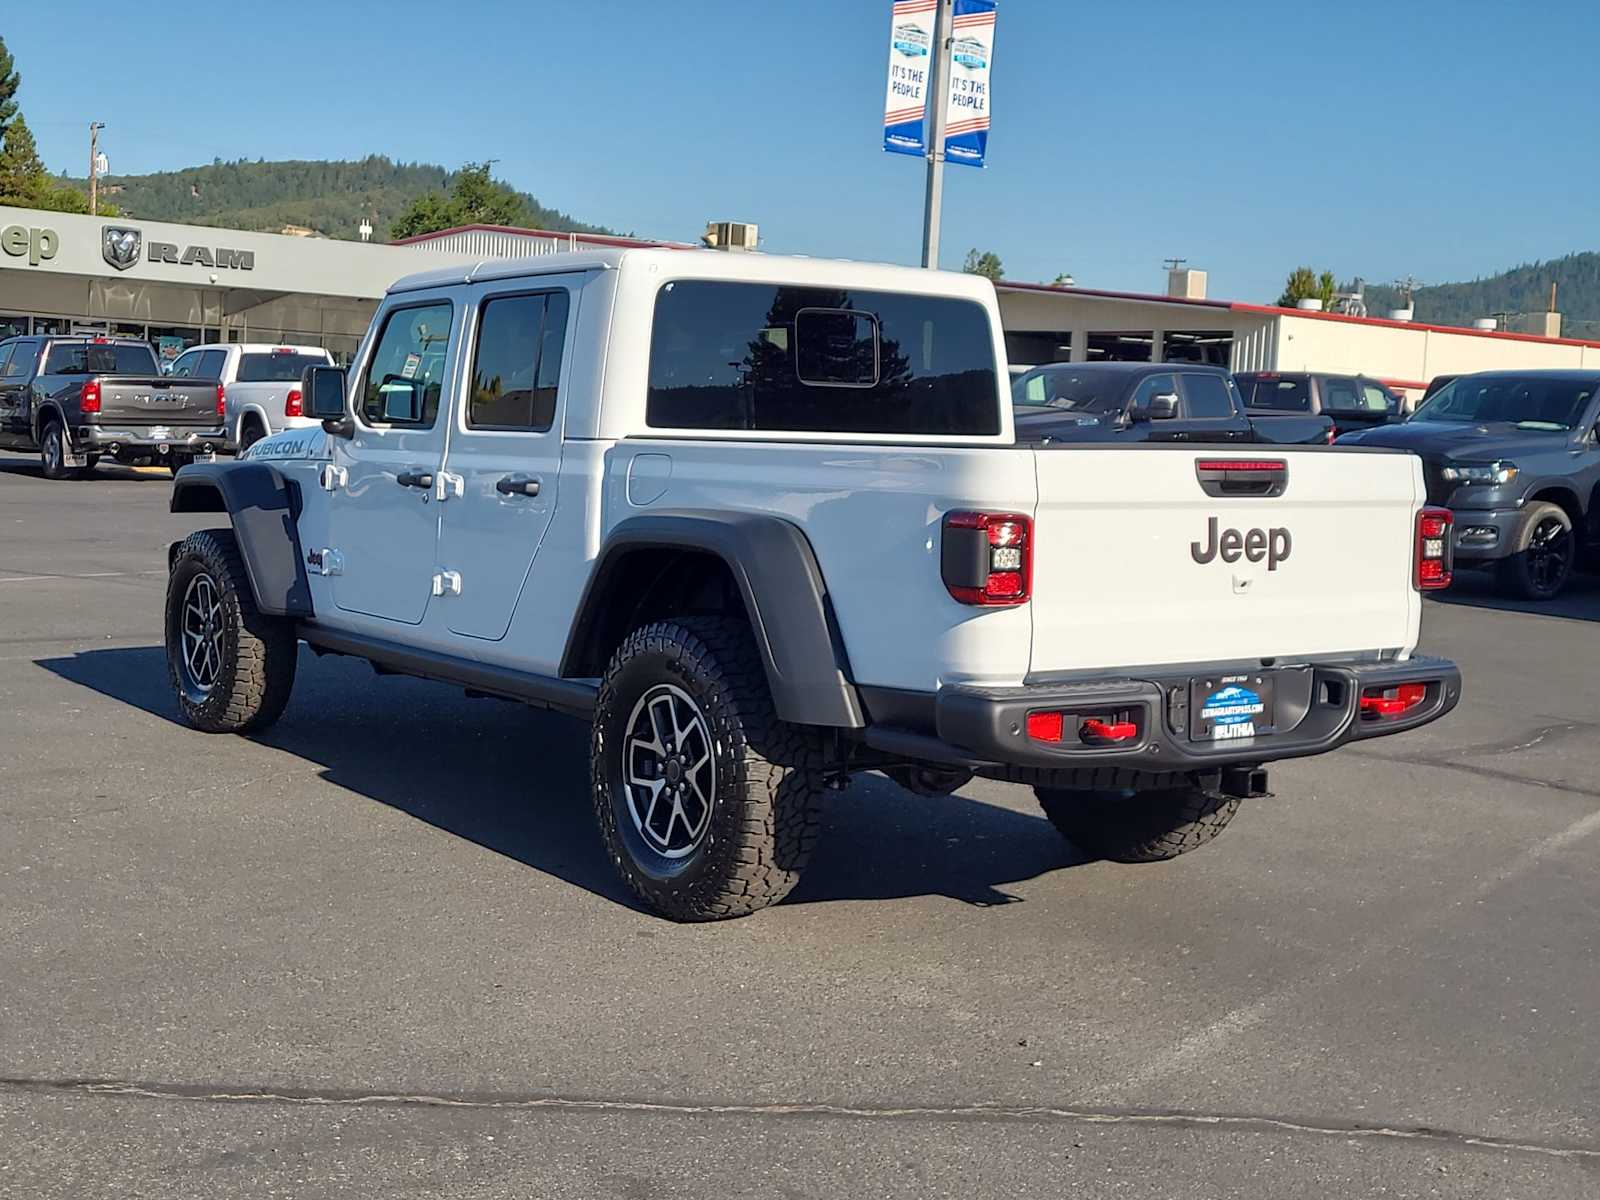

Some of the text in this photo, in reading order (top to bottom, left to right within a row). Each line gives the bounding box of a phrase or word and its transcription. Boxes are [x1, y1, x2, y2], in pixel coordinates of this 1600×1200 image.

[892, 64, 923, 83] IT'S THE
[892, 81, 920, 99] PEOPLE
[952, 77, 986, 95] IT'S THE
[952, 94, 985, 110] PEOPLE
[0, 225, 59, 266] ep
[148, 241, 255, 270] RAM
[250, 440, 304, 456] RUBICON
[1191, 517, 1292, 571] Jeep
